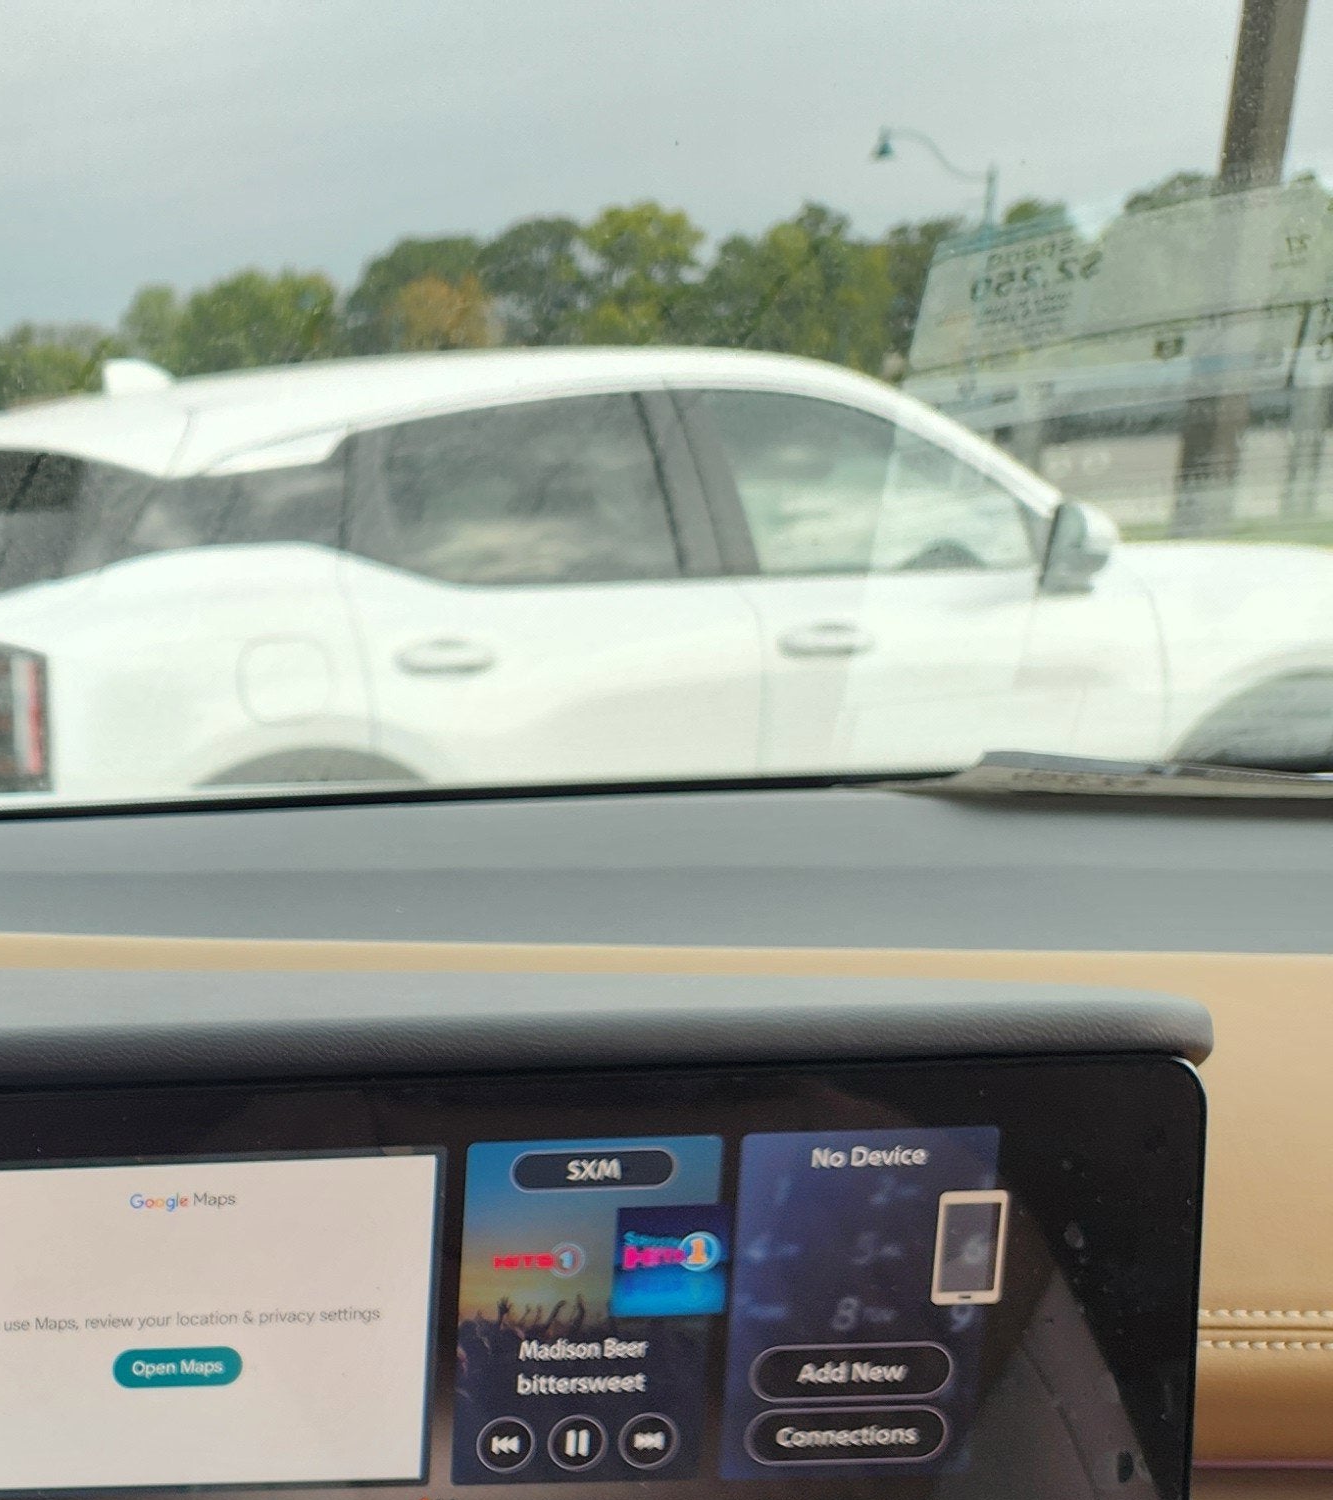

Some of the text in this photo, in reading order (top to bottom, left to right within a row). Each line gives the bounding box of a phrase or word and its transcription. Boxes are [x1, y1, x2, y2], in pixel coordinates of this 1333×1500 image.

[811, 1145, 928, 1168] No Device
[565, 1158, 622, 1181] SXM
[129, 1191, 236, 1212] Google Maps
[3, 1320, 31, 1332] use
[35, 1316, 80, 1334] Maps,
[84, 1314, 134, 1330] review
[138, 1313, 171, 1332] your
[176, 1310, 238, 1327] location
[243, 1311, 254, 1325] &
[259, 1309, 314, 1327] privacy
[319, 1307, 381, 1324] settings
[518, 1337, 649, 1361] Madison Beer
[132, 1359, 223, 1379] Open Maps
[796, 1361, 909, 1384] Add New
[517, 1372, 648, 1395] bittersweet
[775, 1424, 920, 1448] Connections
